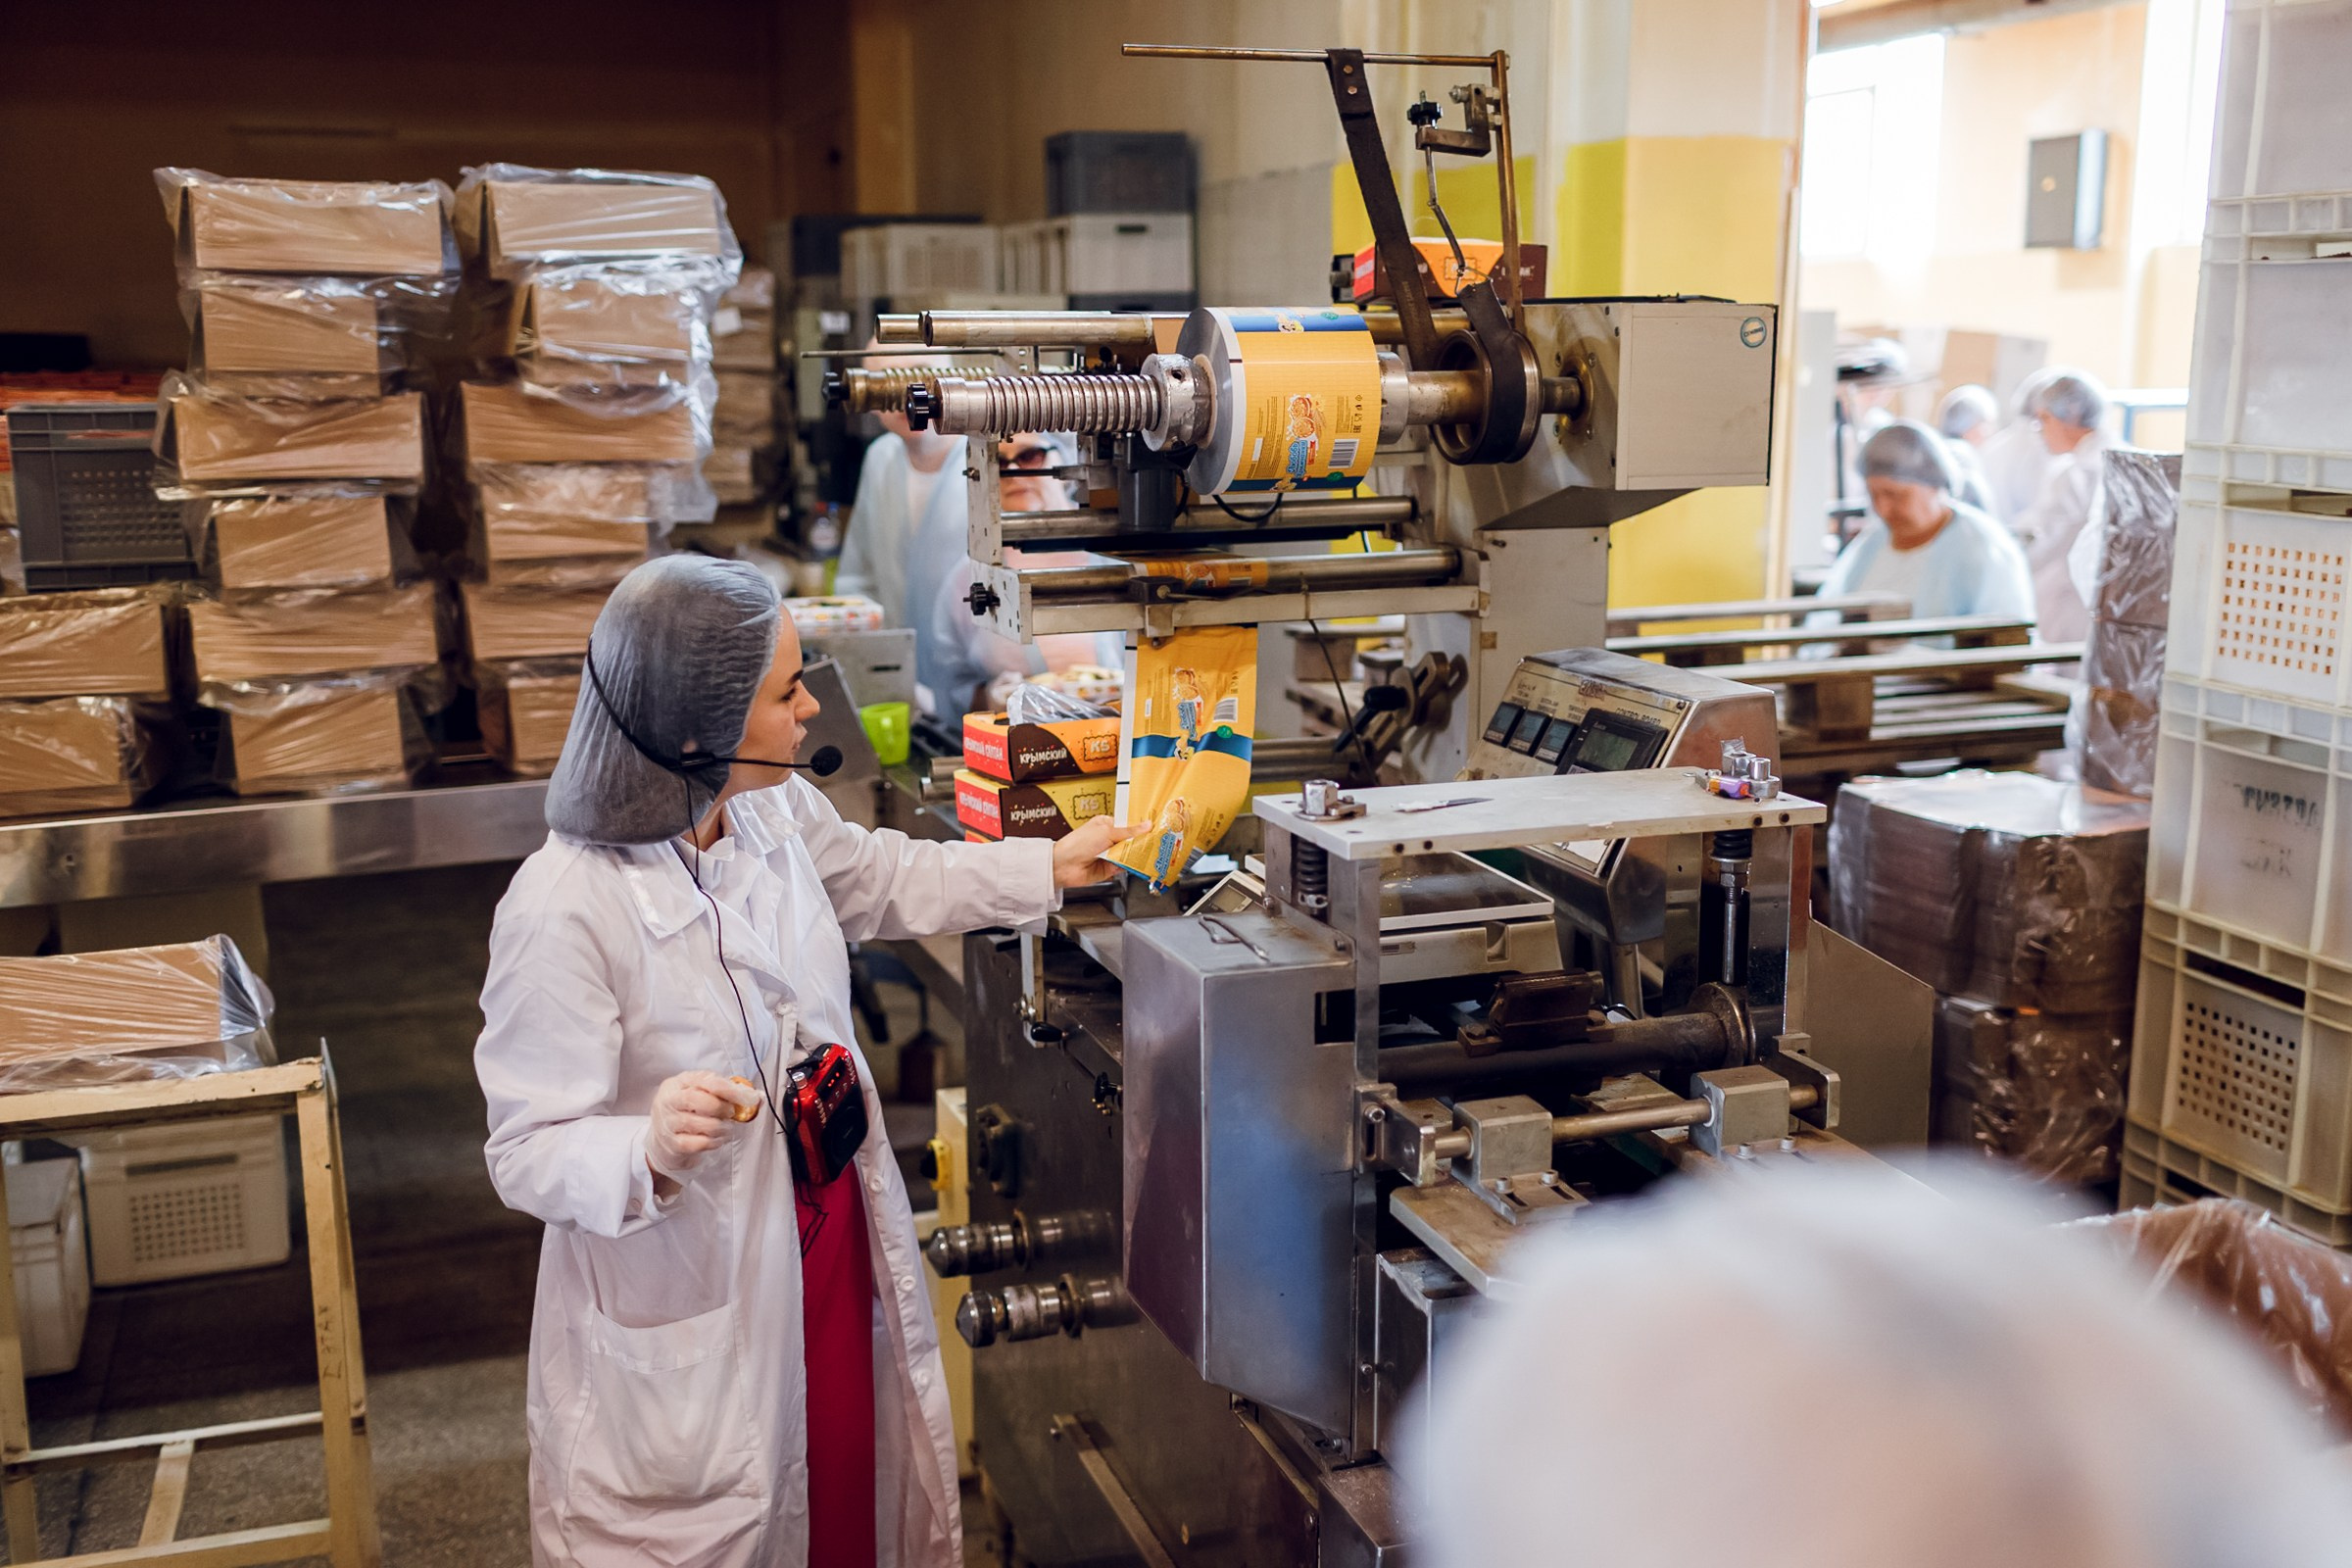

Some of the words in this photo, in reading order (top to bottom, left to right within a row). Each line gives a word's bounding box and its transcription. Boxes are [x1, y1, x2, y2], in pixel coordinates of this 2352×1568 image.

[1090, 739, 1110, 753] KS
[1019, 748, 1067, 764] КРЫМСКИЙ
[1080, 798, 1100, 811] KS
[1010, 806, 1057, 822] КРЫМСКИЙ
